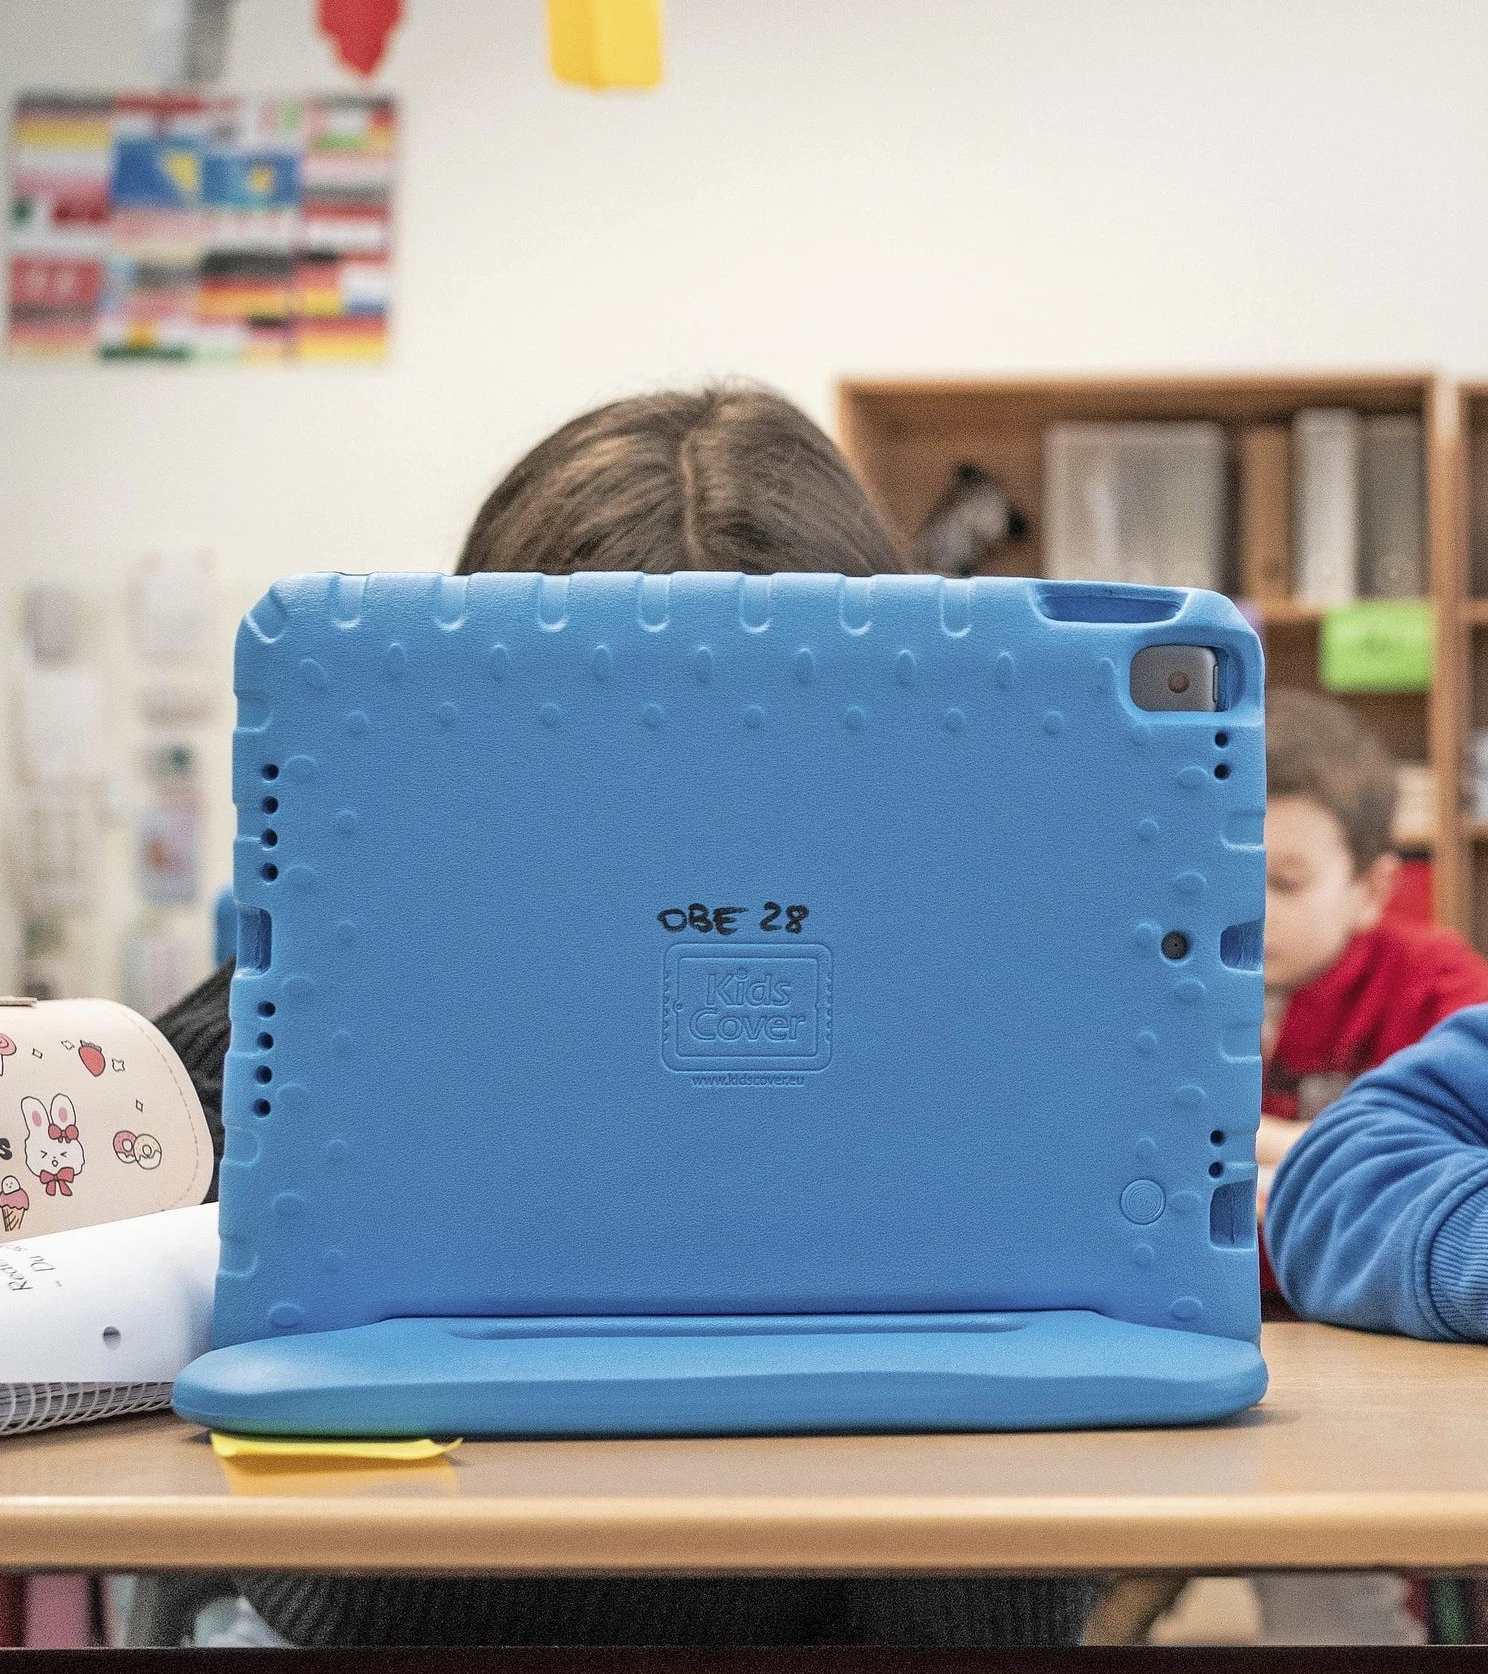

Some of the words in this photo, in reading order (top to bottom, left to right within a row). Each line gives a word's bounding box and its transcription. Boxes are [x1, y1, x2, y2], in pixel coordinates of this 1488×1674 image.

[657, 903, 749, 935] OBE
[760, 901, 809, 934] 28
[706, 967, 792, 1008] Kids
[689, 1006, 806, 1042] Cover
[691, 1074, 805, 1088] www.kidscover.eu
